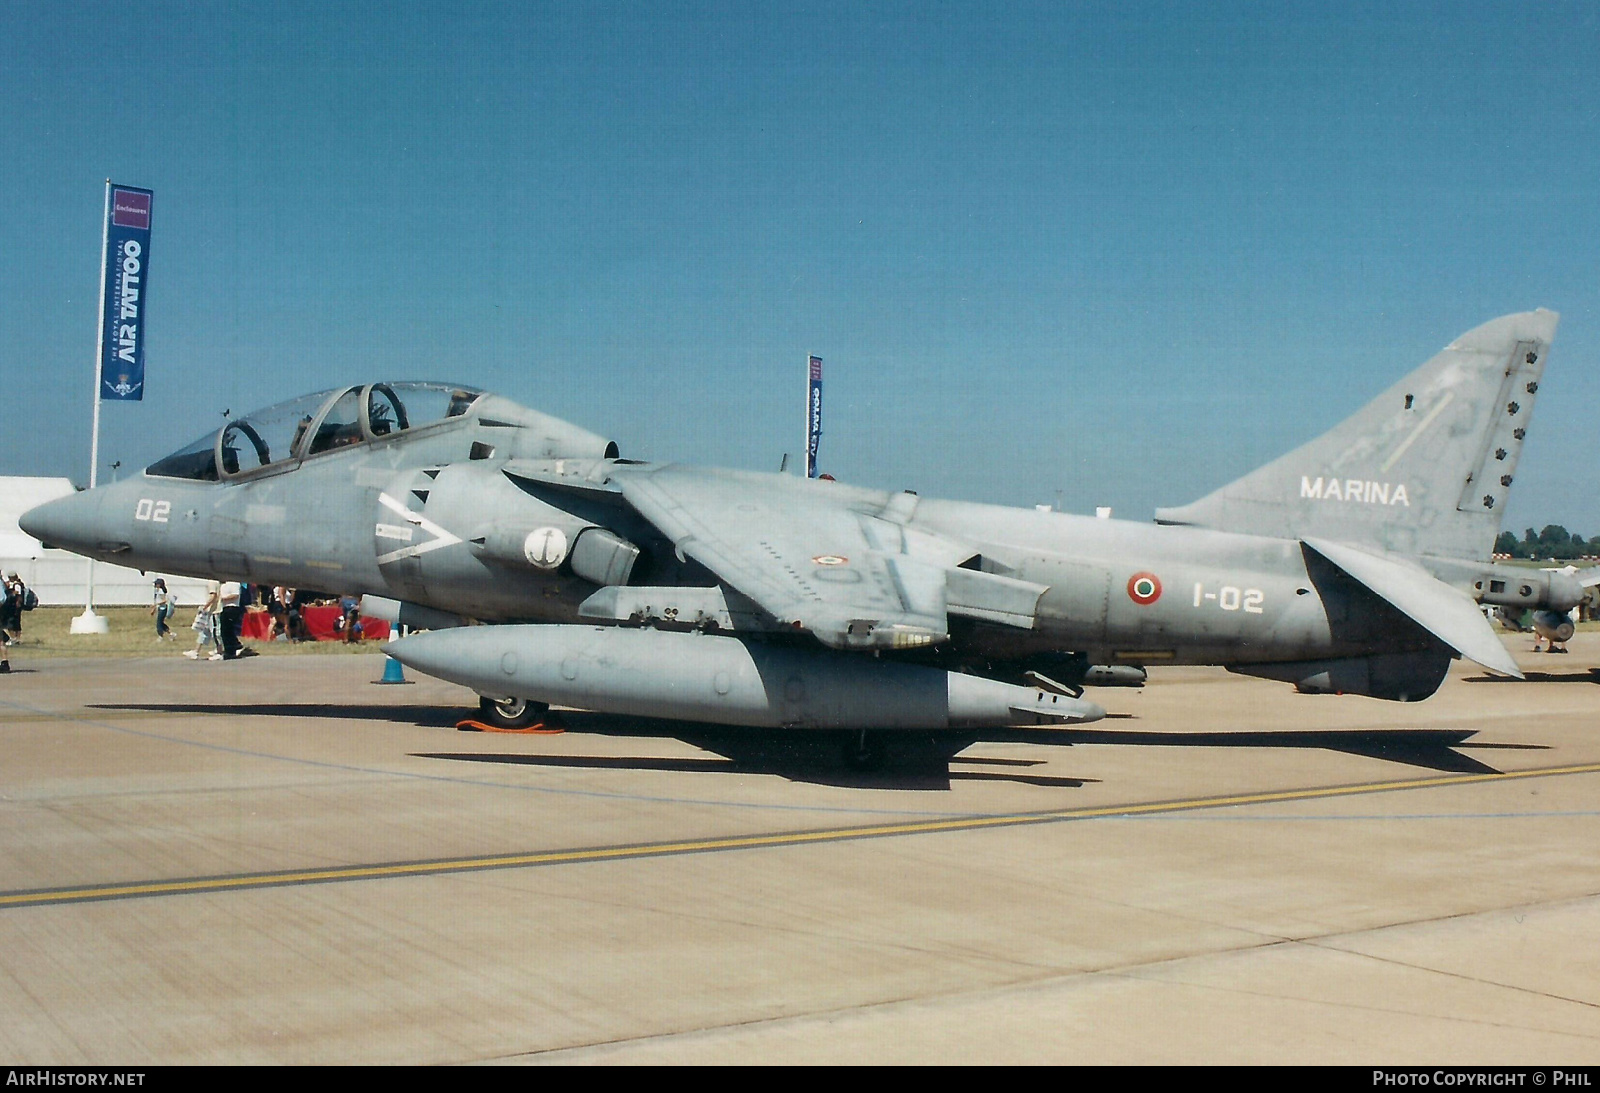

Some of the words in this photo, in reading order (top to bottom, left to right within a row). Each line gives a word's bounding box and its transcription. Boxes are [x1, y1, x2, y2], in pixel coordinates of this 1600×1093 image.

[113, 239, 124, 311] INTERNATIONAL
[120, 240, 142, 321] TATTOO
[118, 323, 137, 364] AIR
[136, 499, 171, 522] 02
[1301, 476, 1410, 507] MARINA
